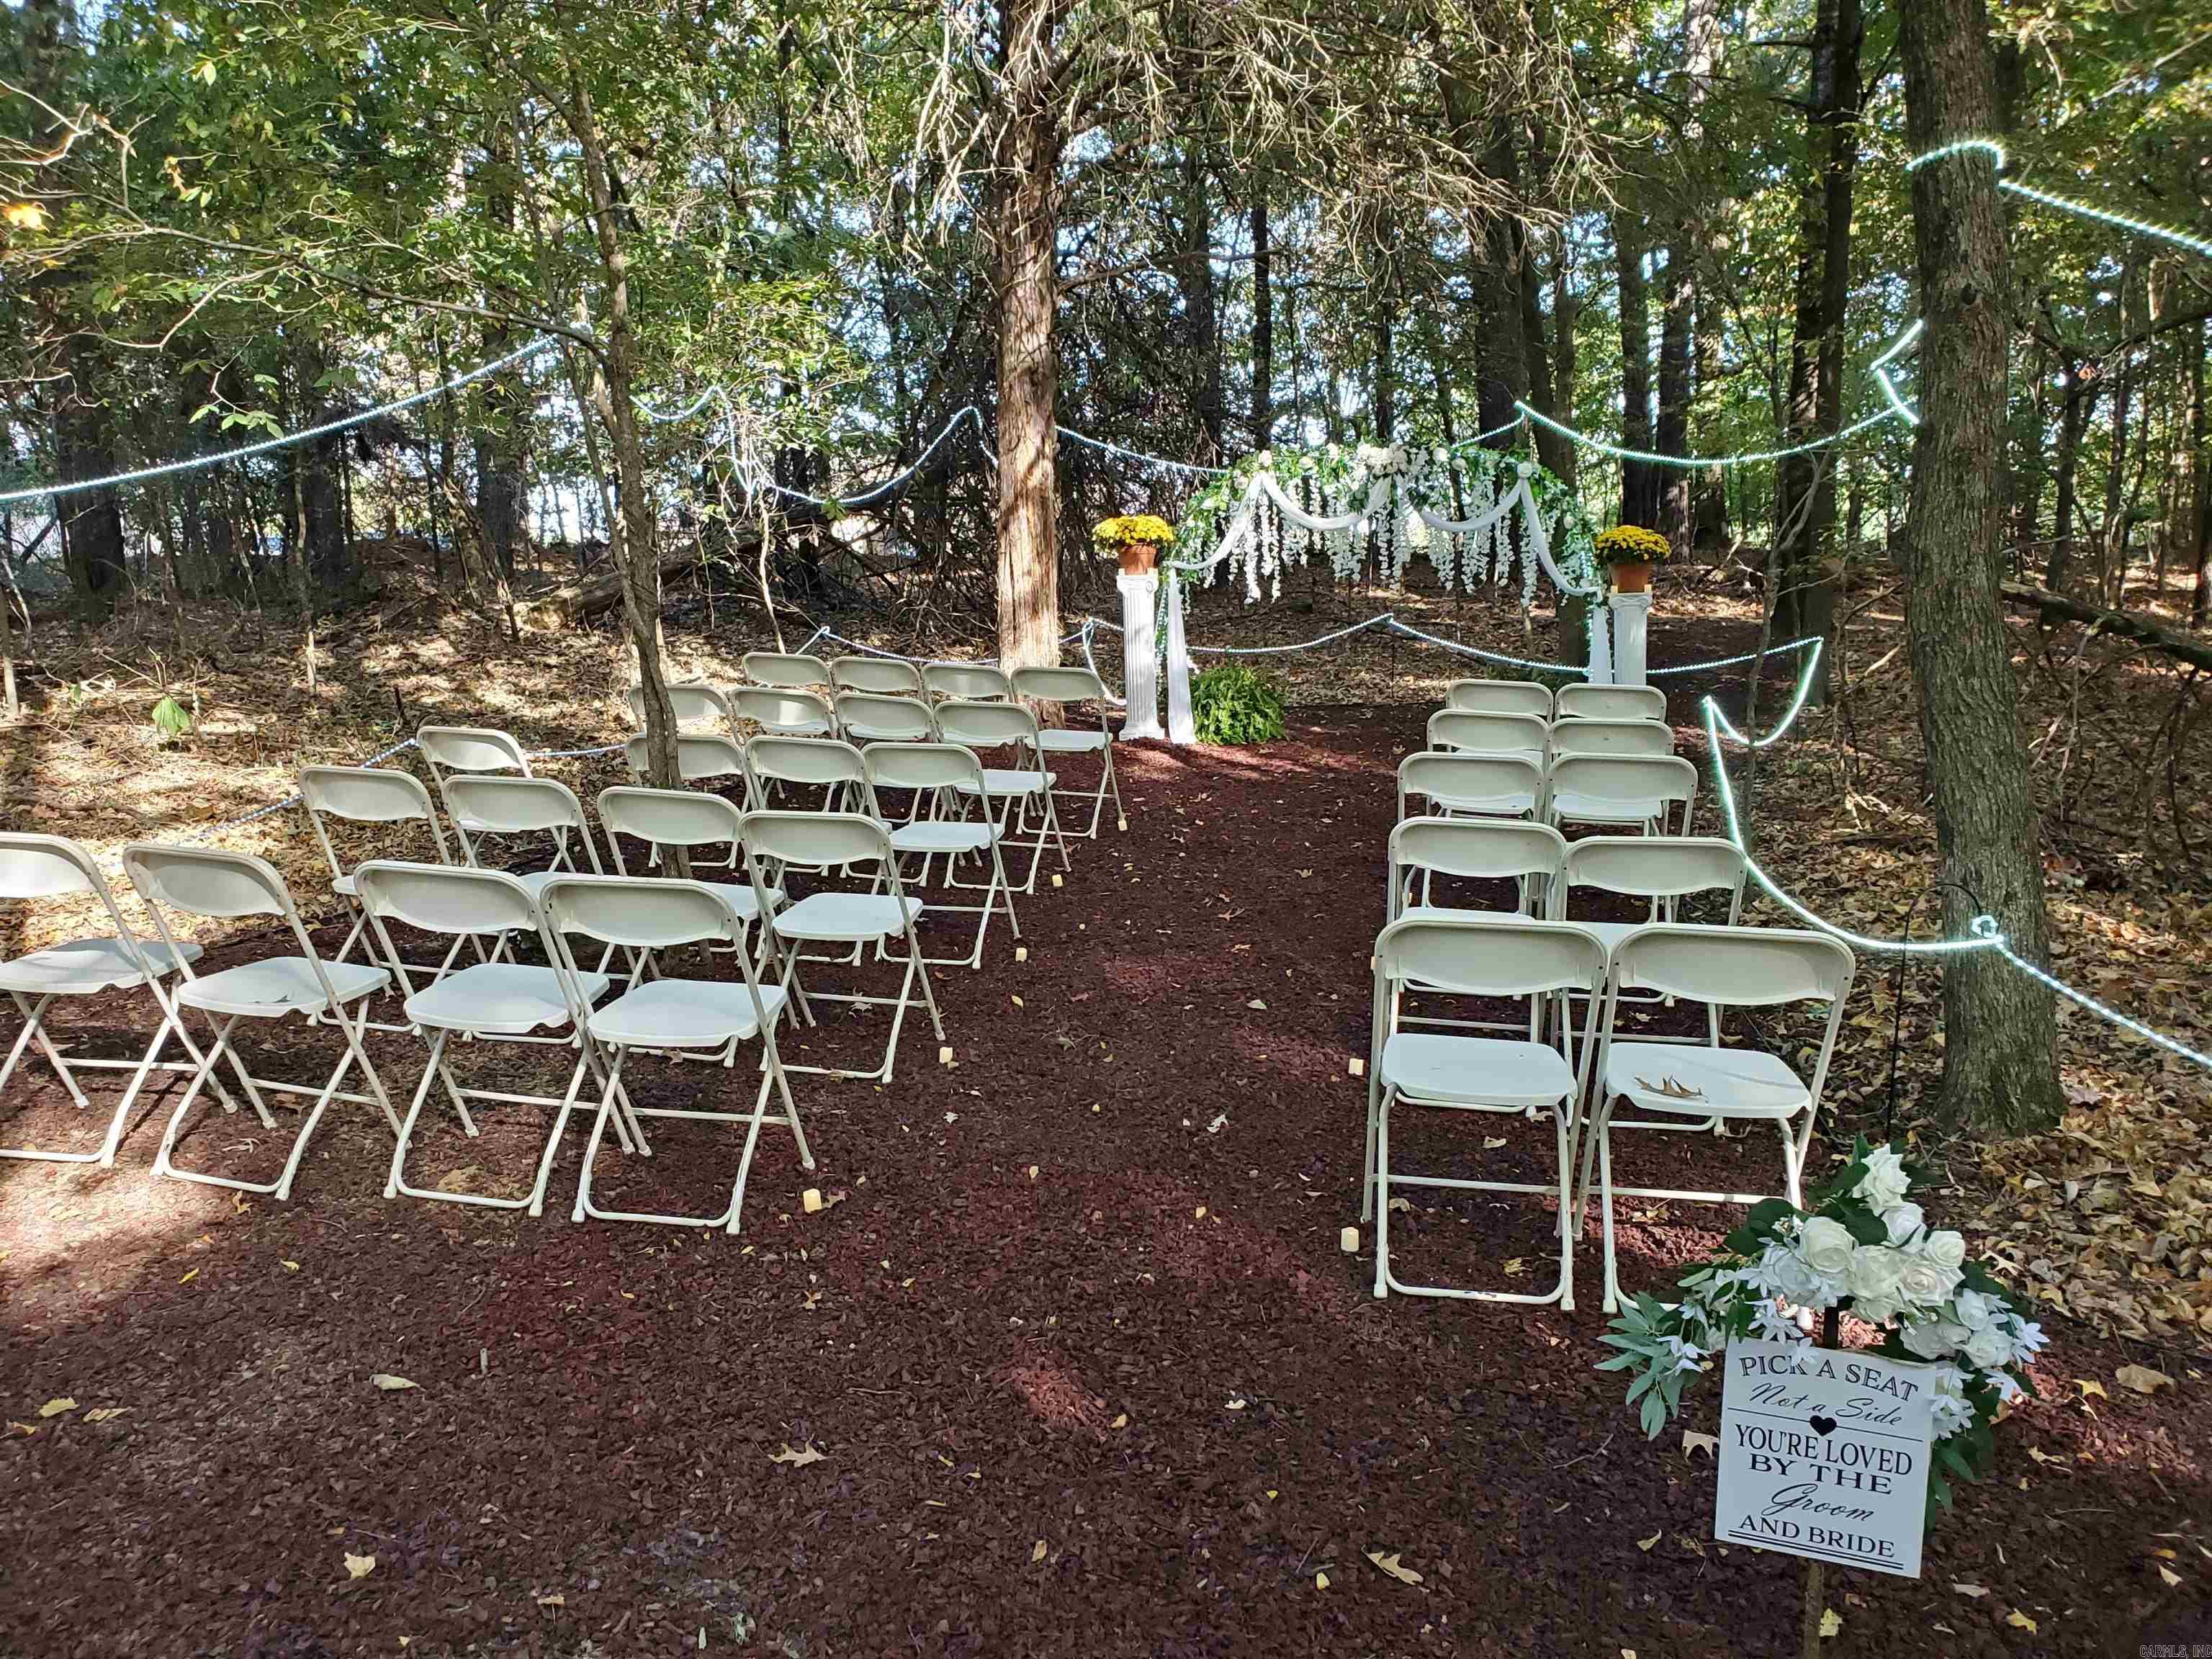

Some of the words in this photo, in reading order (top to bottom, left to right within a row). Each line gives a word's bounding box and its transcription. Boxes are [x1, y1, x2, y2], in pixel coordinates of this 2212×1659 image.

[1738, 1354, 1809, 1377] PICK
[1815, 1359, 1837, 1380] A
[1844, 1364, 1919, 1402] SEAT
[1749, 1382, 1809, 1409] Not
[1808, 1403, 1826, 1413] a
[1835, 1398, 1902, 1426] Side
[1748, 1453, 1798, 1476] BY
[1809, 1463, 1892, 1495] THE
[1825, 1439, 1912, 1475] LOVED
[1761, 1483, 1874, 1521] Groom
[1738, 1514, 1800, 1539] AND
[1808, 1526, 1895, 1558] BRIDE
